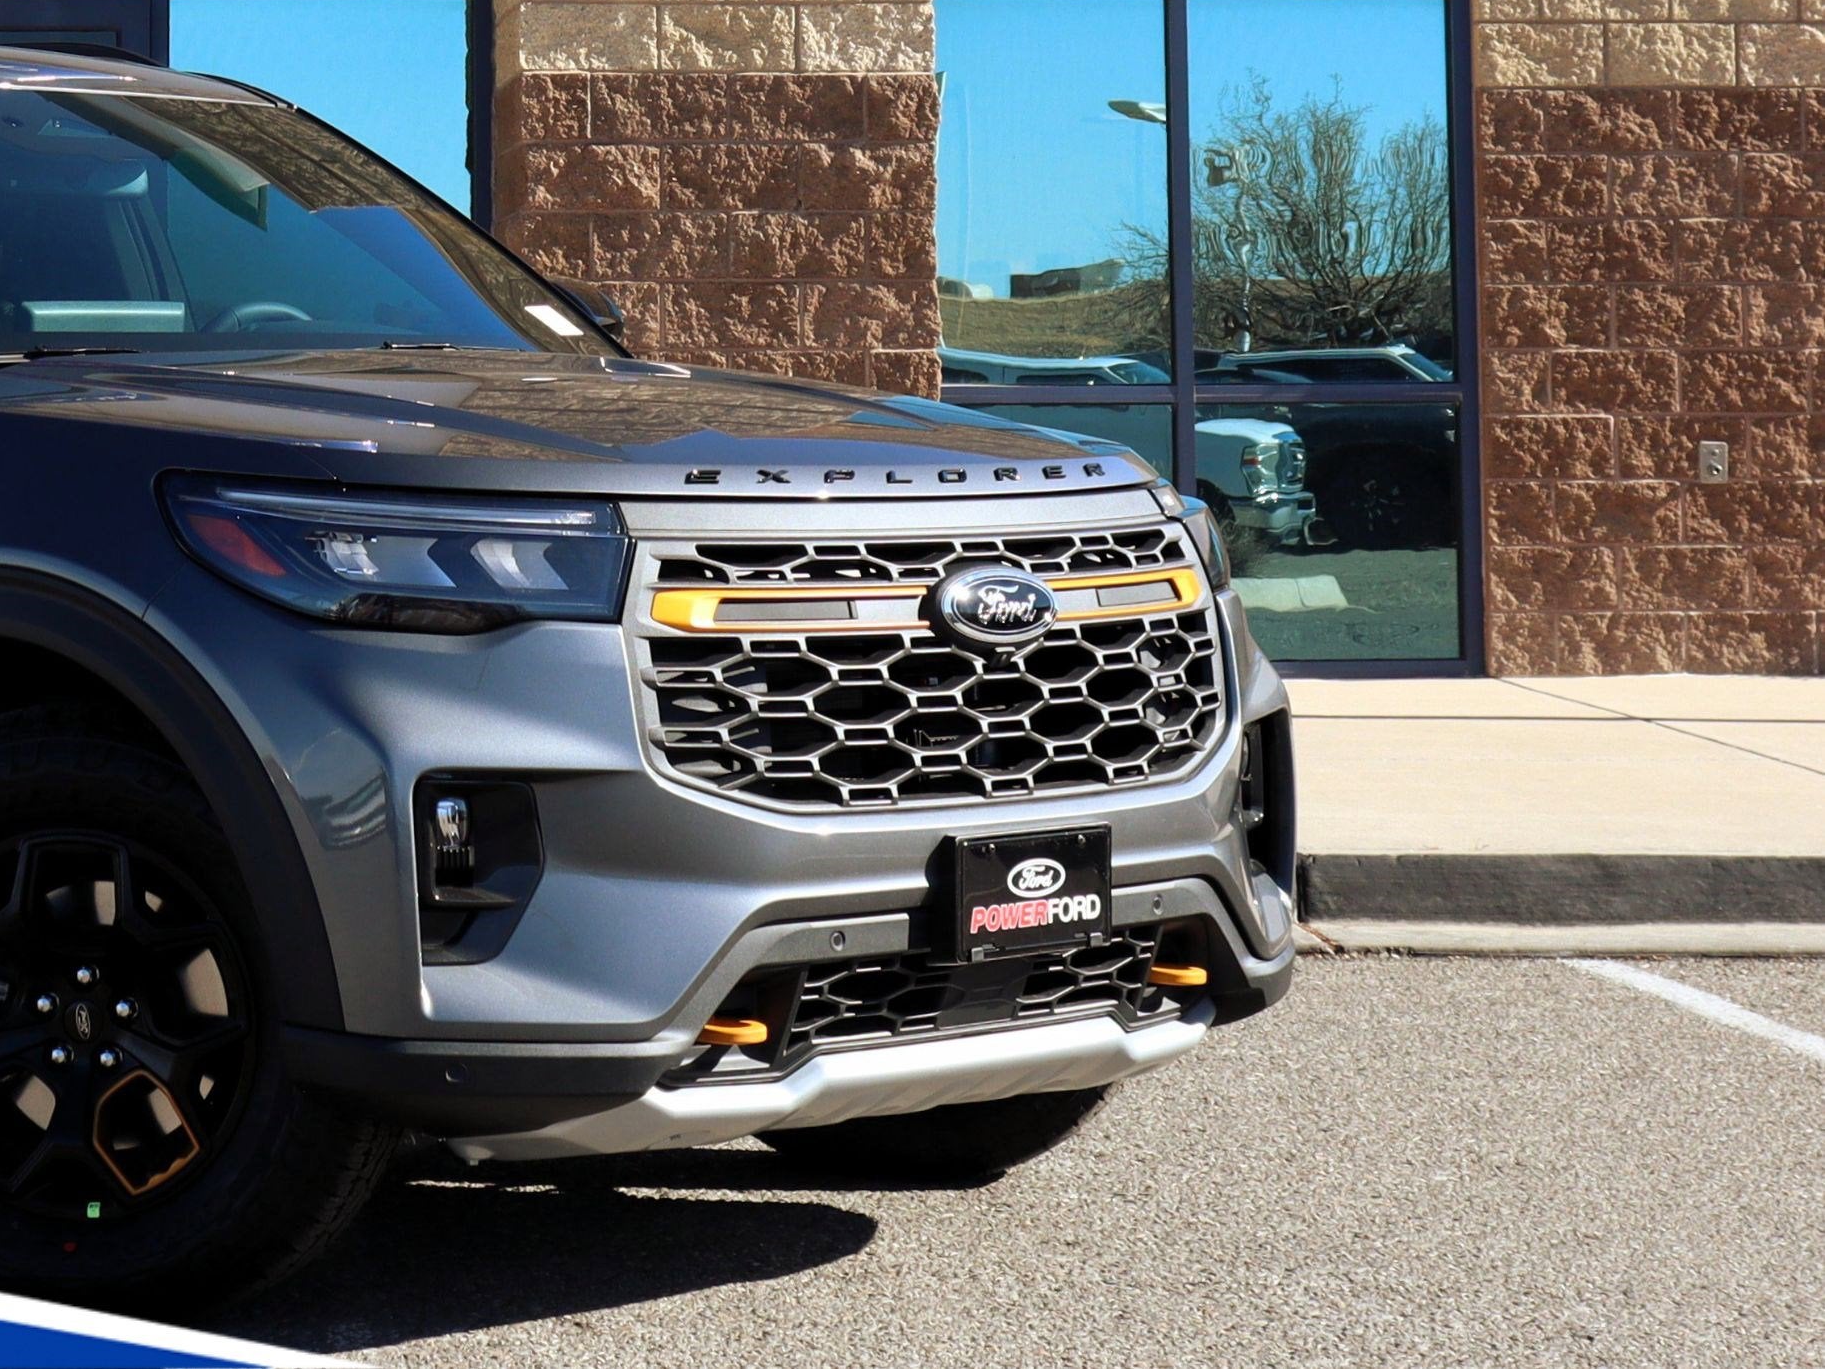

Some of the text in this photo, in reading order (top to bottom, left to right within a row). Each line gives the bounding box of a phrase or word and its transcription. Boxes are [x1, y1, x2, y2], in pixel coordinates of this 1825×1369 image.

[684, 463, 1106, 484] EXPLORER
[977, 584, 1037, 625] Ford
[1019, 864, 1053, 889] Ford
